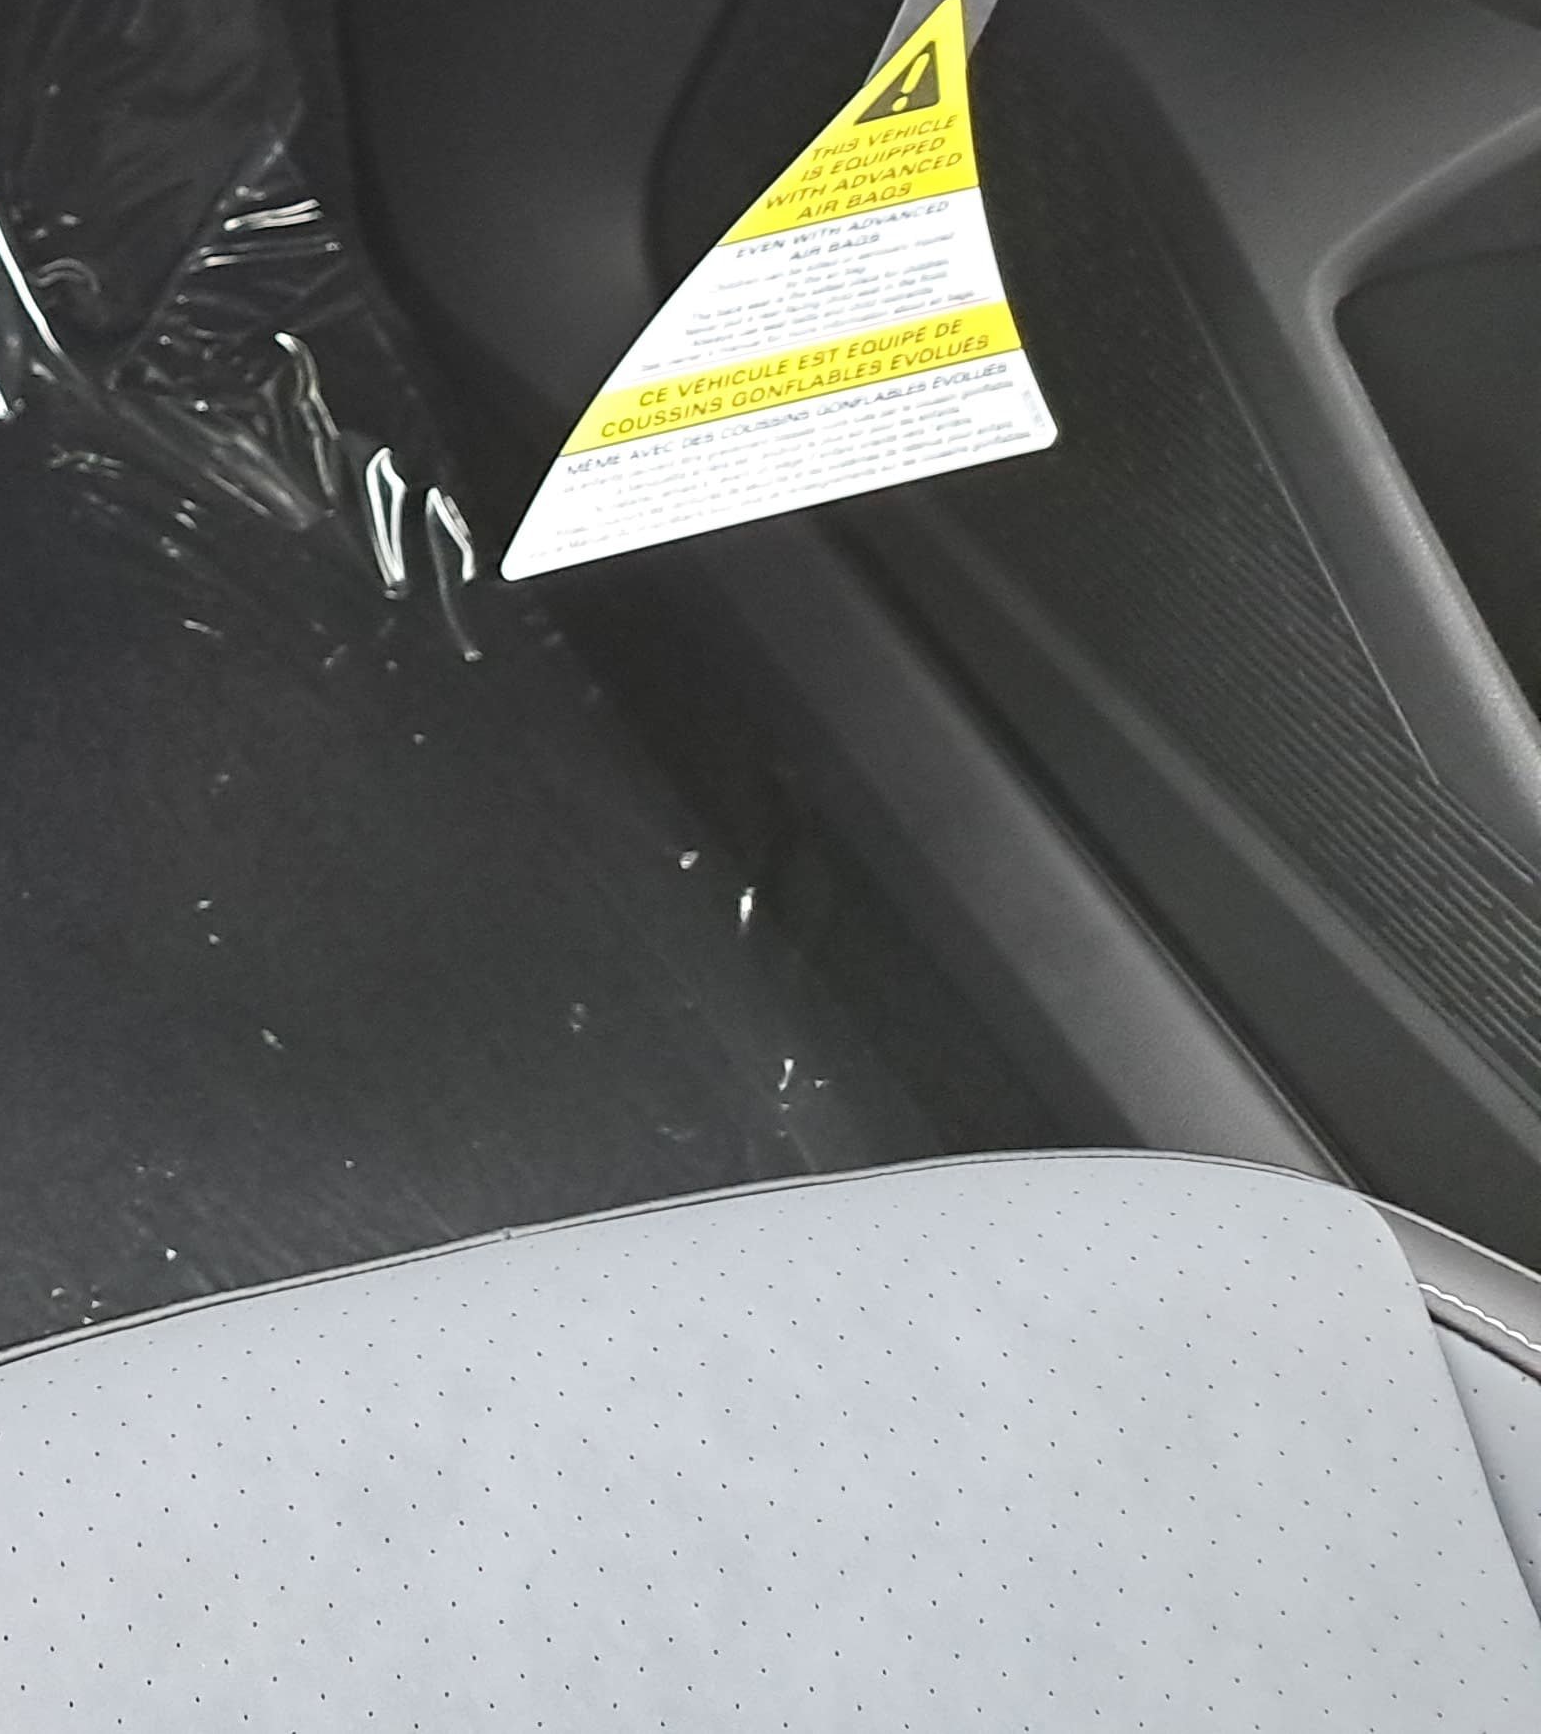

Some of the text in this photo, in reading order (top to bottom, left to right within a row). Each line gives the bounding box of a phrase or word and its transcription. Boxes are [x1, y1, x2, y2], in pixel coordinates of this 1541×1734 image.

[801, 137, 945, 183] IS EQUIPPED
[813, 114, 958, 162] THIS VEHICLE
[766, 152, 963, 209] WITH ADVANCED
[796, 182, 912, 221] AIR BAGS
[736, 200, 950, 259] EVEN WITH ADVANCED
[639, 387, 669, 407] CE
[798, 347, 840, 371] EST
[934, 319, 963, 339] DE
[601, 397, 722, 438] COUSSINS
[731, 360, 882, 408] GONFLABLES
